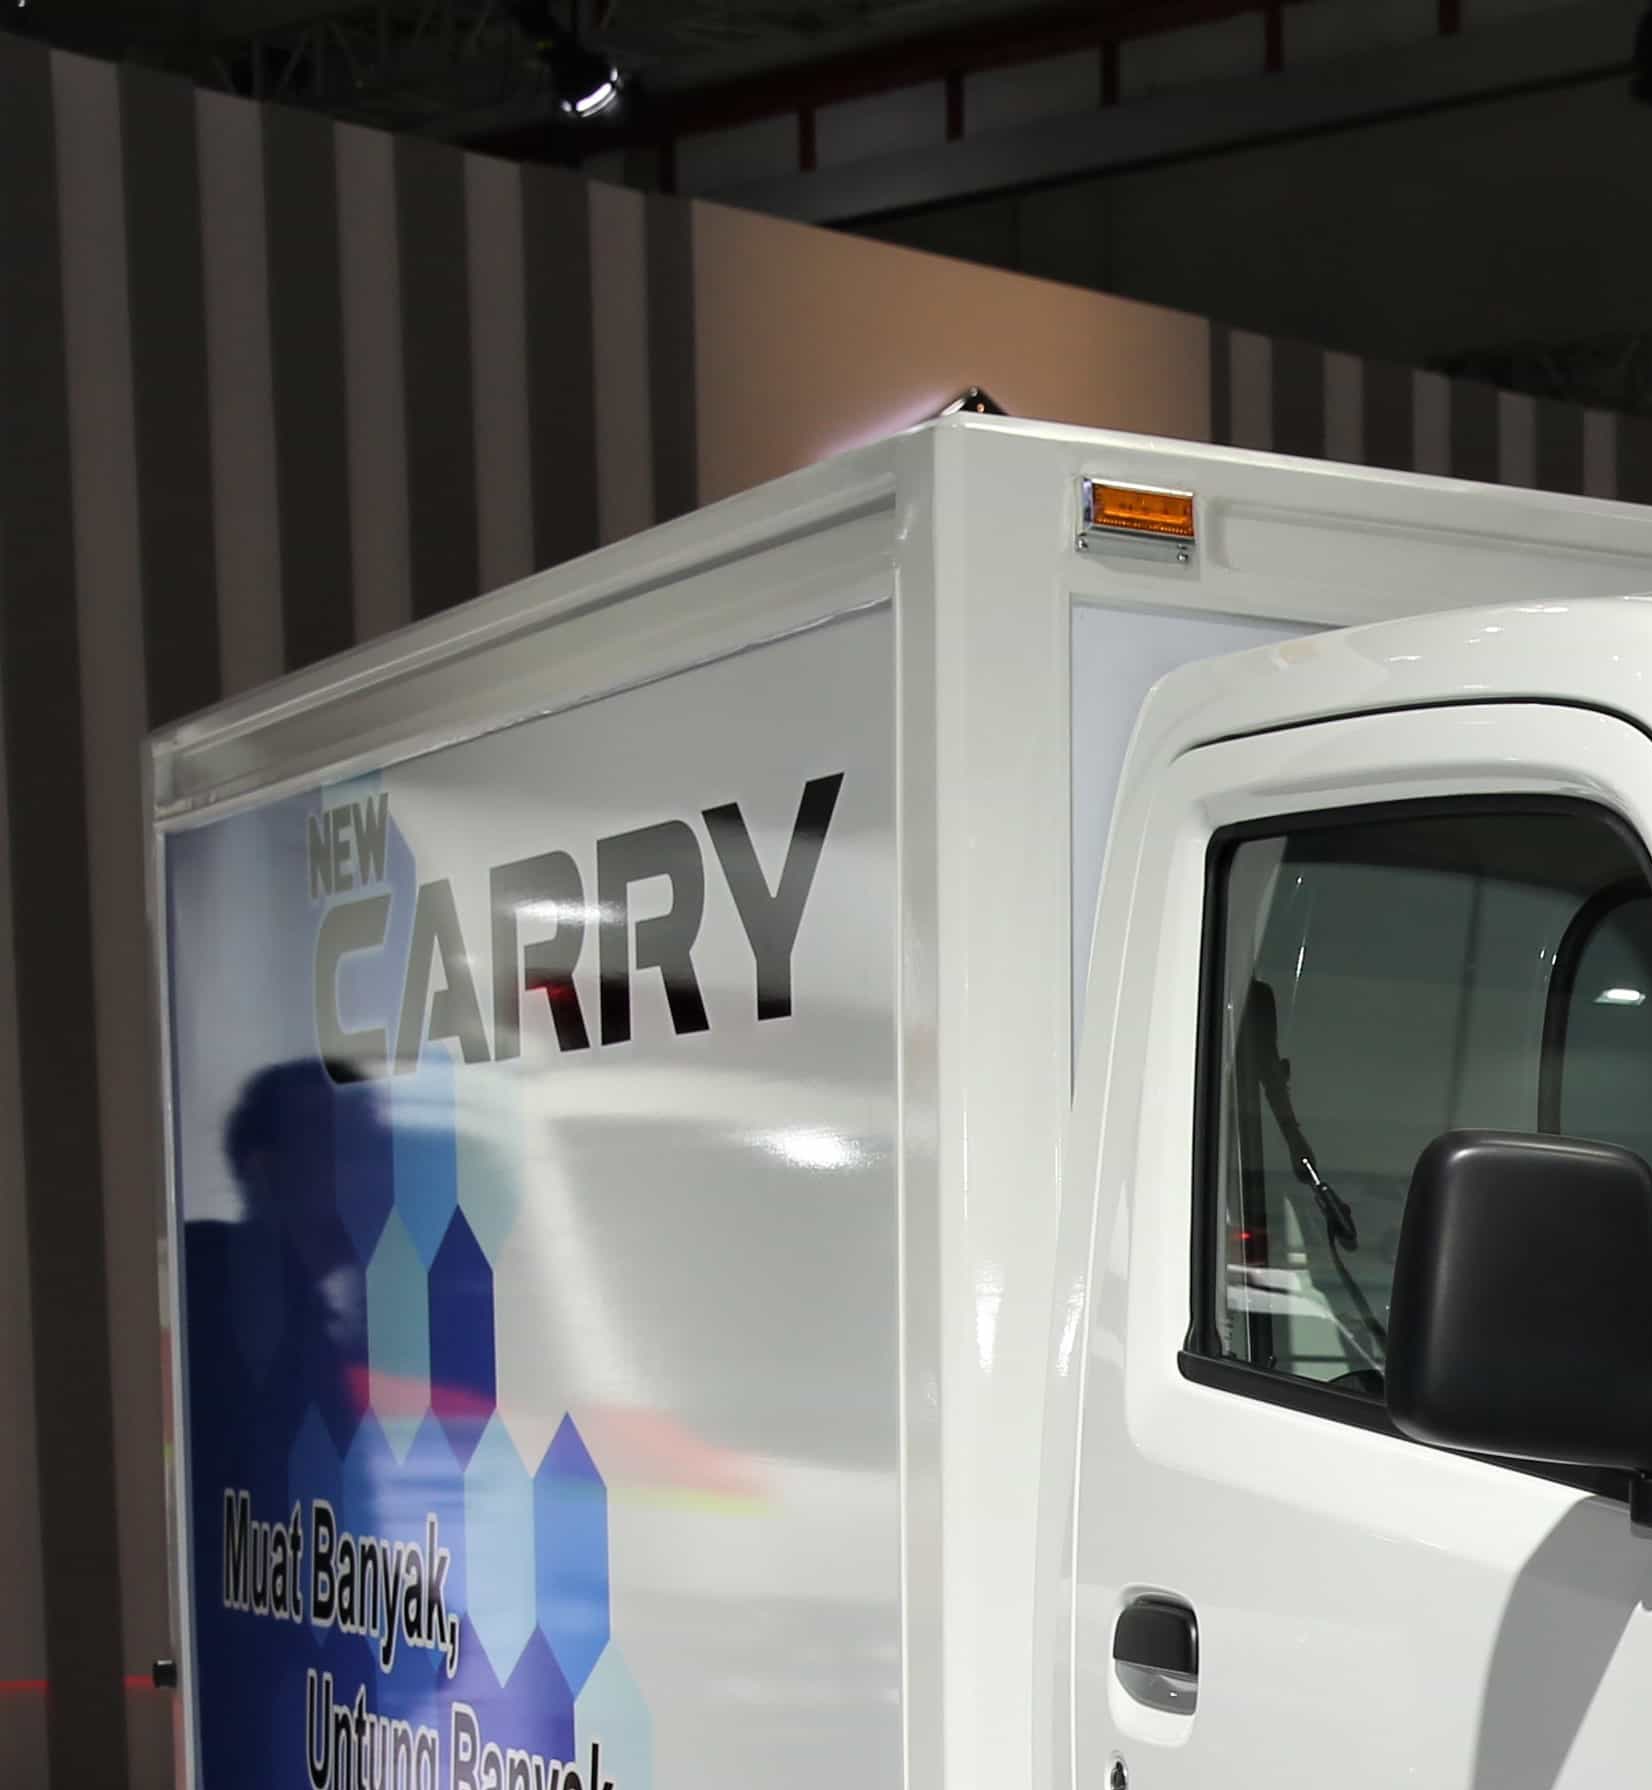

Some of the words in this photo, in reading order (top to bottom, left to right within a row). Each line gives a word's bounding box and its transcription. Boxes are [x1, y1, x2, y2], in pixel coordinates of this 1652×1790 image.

[307, 792, 390, 898] NEW
[312, 772, 845, 1086] CARRY
[223, 1488, 305, 1621] Muat
[310, 1499, 461, 1678] Banyak,
